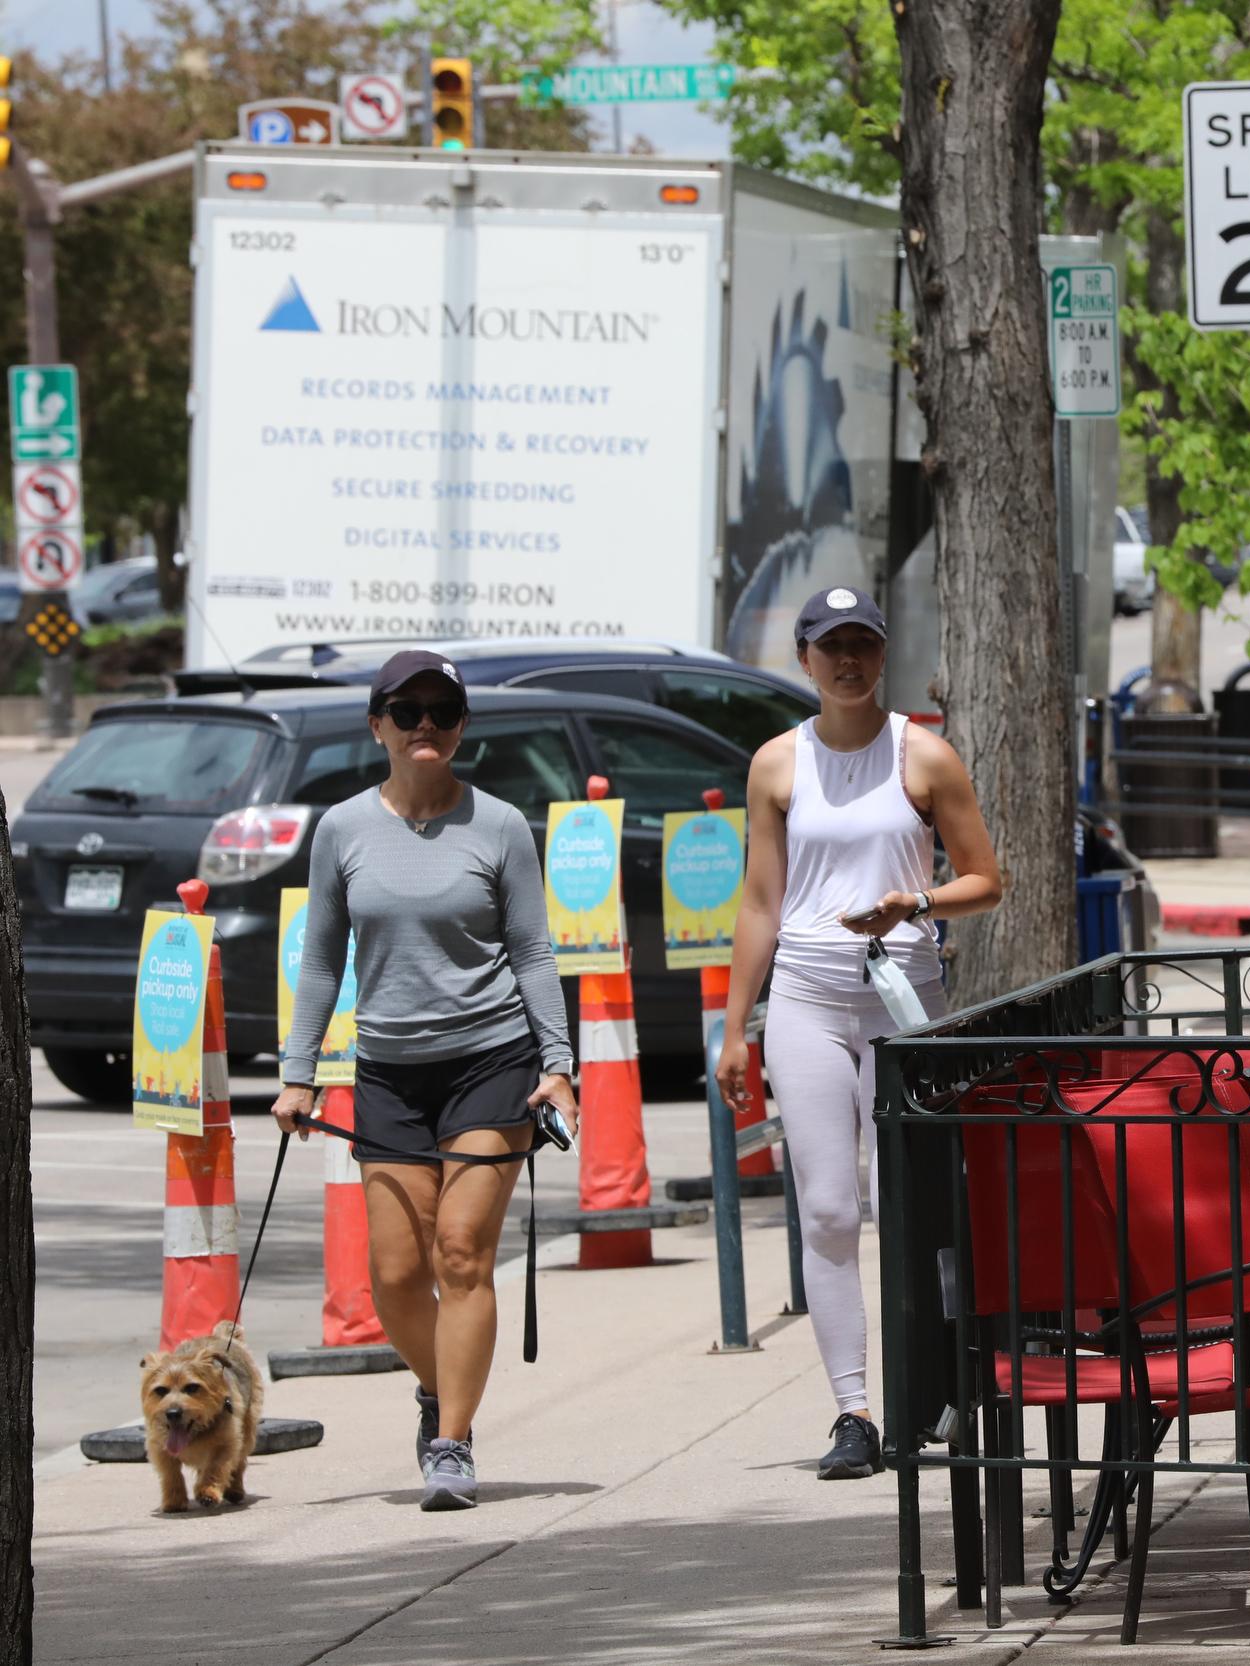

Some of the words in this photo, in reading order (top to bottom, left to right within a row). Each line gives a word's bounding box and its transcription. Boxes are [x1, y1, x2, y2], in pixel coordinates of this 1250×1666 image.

[553, 70, 687, 101] MOUNTAIN
[230, 231, 296, 250] 12302
[1055, 275, 1069, 313] 2
[1085, 273, 1101, 290] HR
[1072, 294, 1112, 312] PARKING
[338, 301, 430, 337] IRON
[441, 303, 649, 343] MOUNTAIN
[1060, 323, 1085, 340] 8:00
[1088, 322, 1109, 340] A.M.
[1078, 346, 1092, 364] TO
[1061, 371, 1086, 388] 6:00
[1090, 370, 1111, 388] P.M.
[301, 378, 415, 401] RECORDS
[426, 383, 611, 405] MANAGEMENT
[261, 426, 324, 446] DATA
[334, 428, 485, 451] PROTECTION
[496, 432, 515, 451] &
[526, 434, 649, 456] RECOVERY
[332, 478, 420, 498] SECURE
[431, 481, 575, 503] SHREDDING
[344, 527, 440, 549] DIGITAL
[449, 530, 561, 552] SERVICES
[351, 579, 555, 606] 1-800-899-IRON
[276, 613, 624, 637] WWW.IRONMOUNTAIN.COM
[558, 837, 605, 851] Curbside
[675, 843, 729, 857] Curbside
[551, 856, 588, 874] pickup
[590, 853, 613, 870] only
[670, 860, 709, 875] pickup
[711, 858, 737, 874] only
[149, 955, 193, 977] Curbside
[142, 979, 174, 1001] pickup
[176, 982, 198, 1005] only
